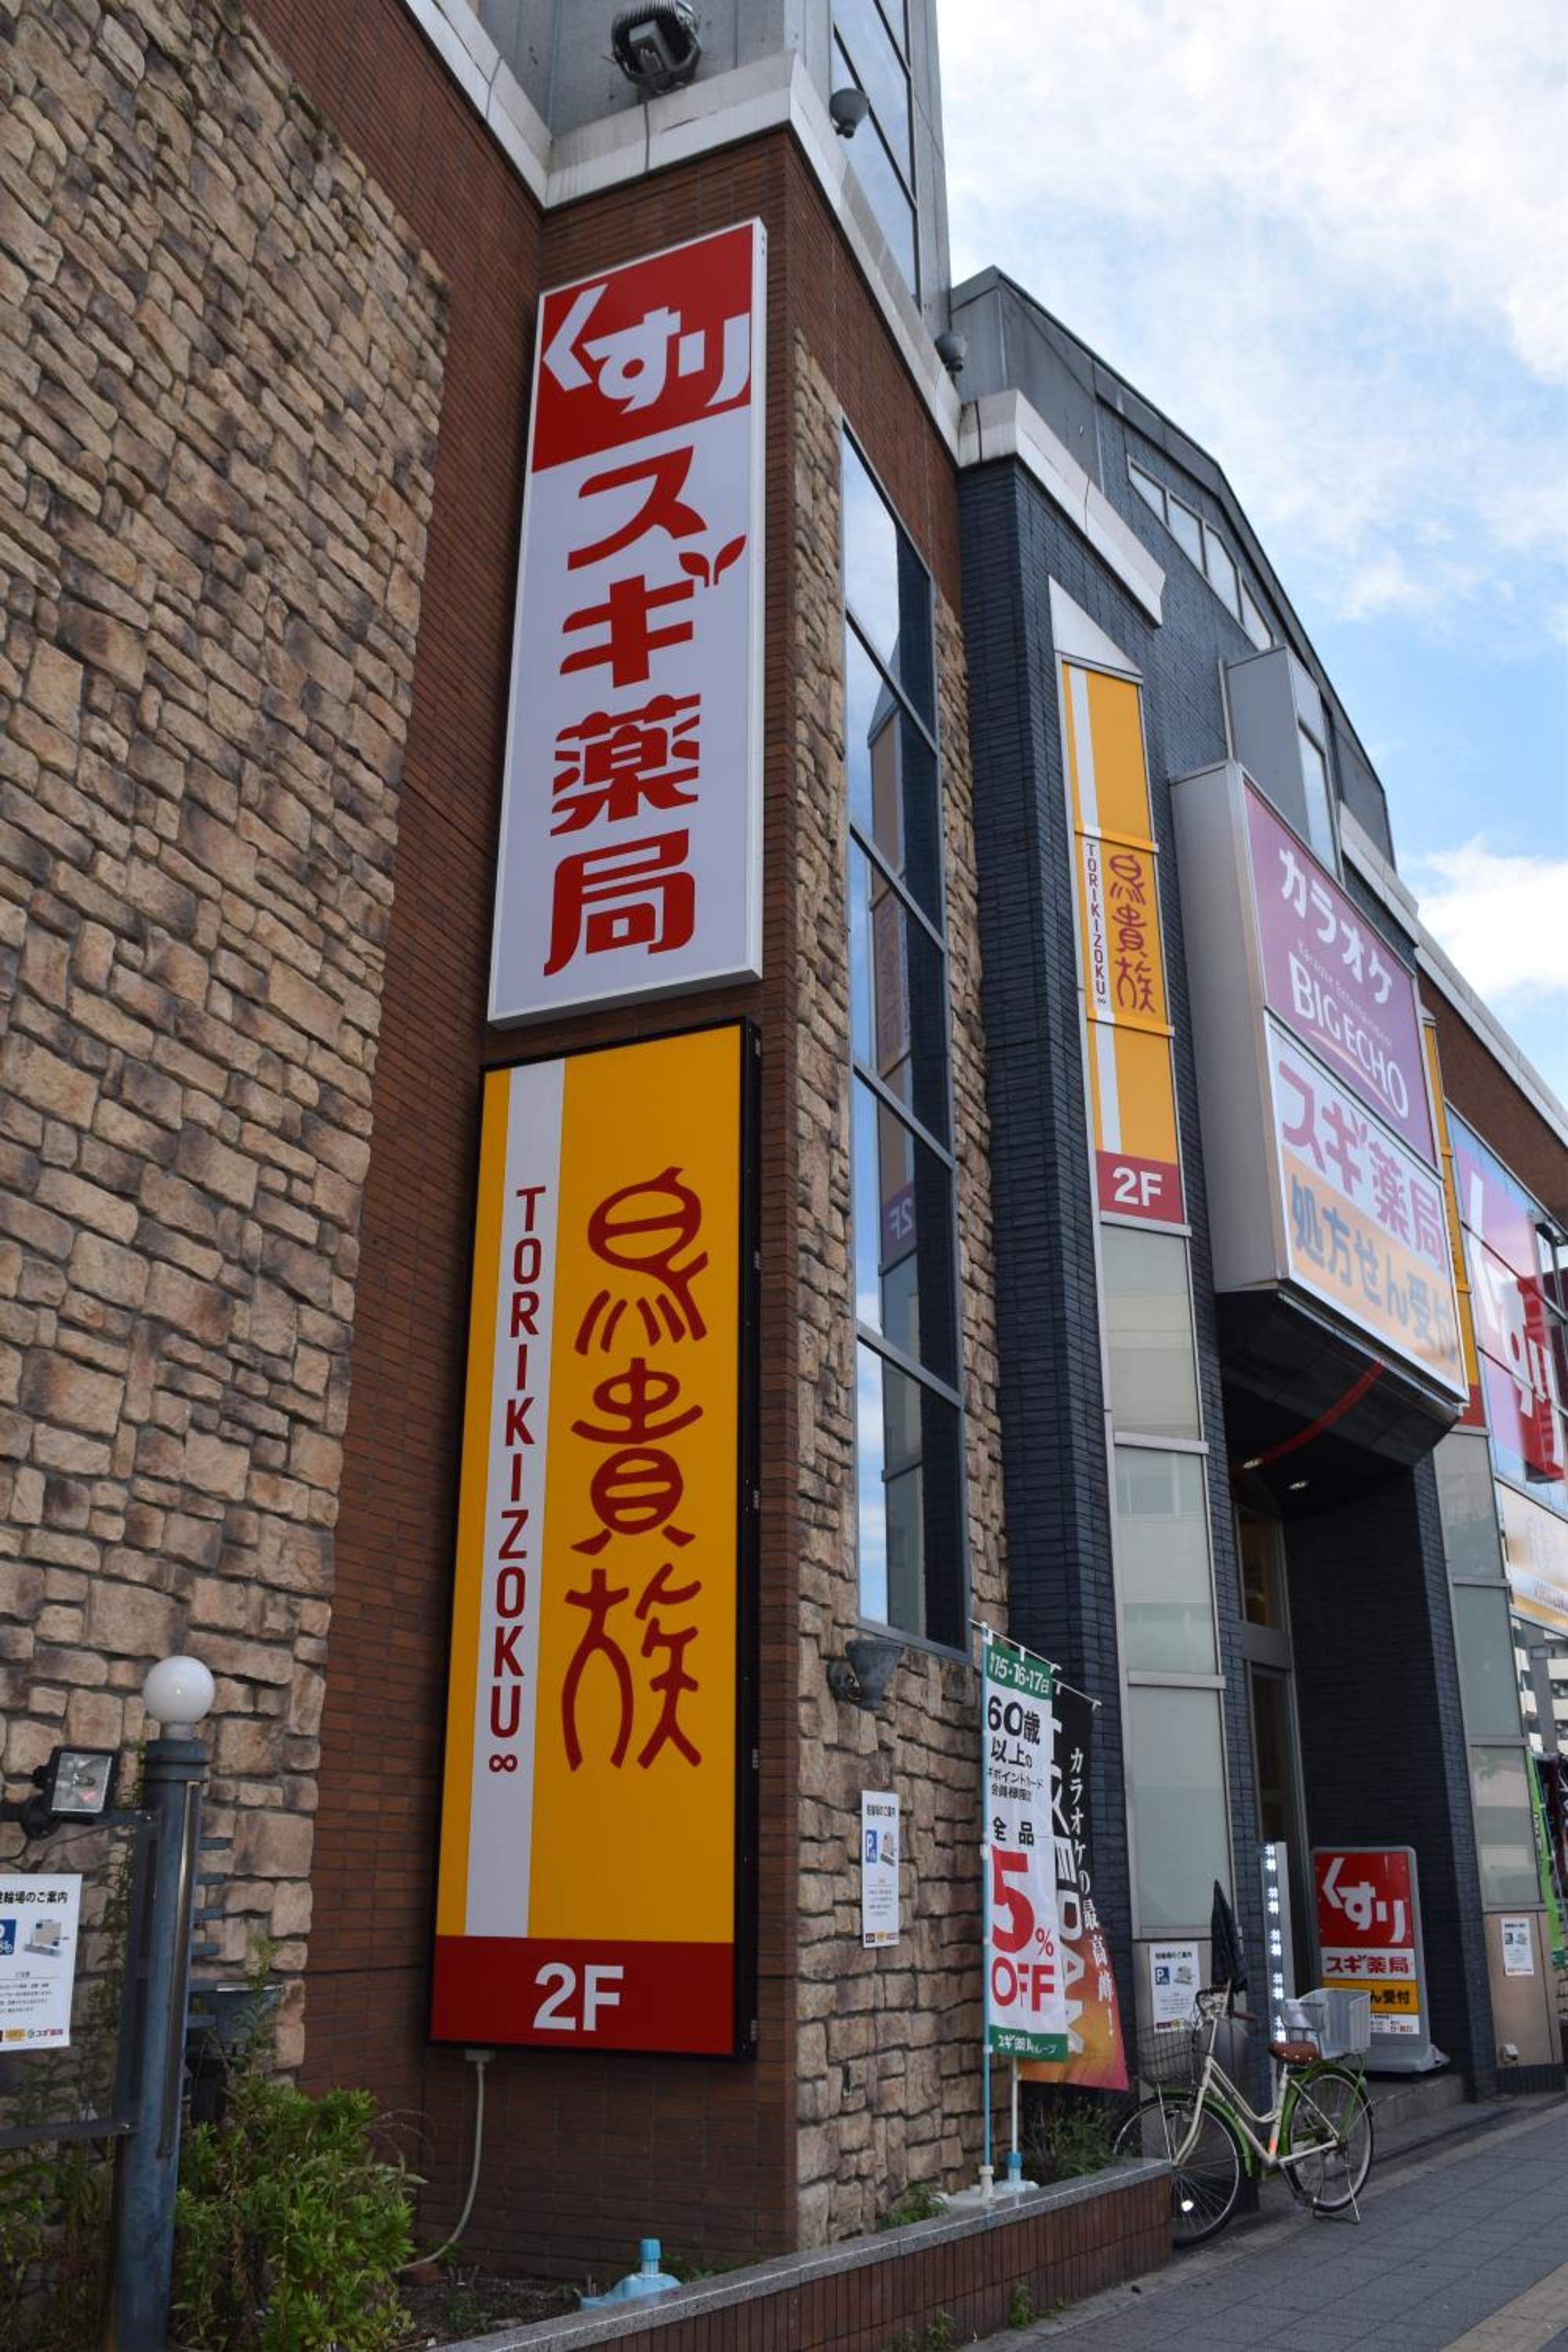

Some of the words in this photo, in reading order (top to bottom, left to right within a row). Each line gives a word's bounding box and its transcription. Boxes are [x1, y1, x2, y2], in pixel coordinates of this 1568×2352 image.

[542, 283, 750, 413] くすり
[543, 444, 746, 977] スギ薬局
[1086, 843, 1105, 996] TORIKIZOKU
[1279, 848, 1393, 1004] カラオケ
[1288, 951, 1341, 1041] BIG
[1342, 1012, 1409, 1119] ECHO
[1111, 1165, 1163, 1207] 2F
[1279, 1060, 1444, 1269] スギ薬局
[1291, 1174, 1456, 1358] 処方せん受付
[488, 1185, 547, 1740] TORIKIZOKU
[987, 1696, 1041, 1745] 60歳
[990, 1737, 1033, 1769] 以上の
[993, 1817, 1034, 1846] 全品
[991, 1844, 1054, 1958] 5%
[1322, 1857, 1406, 1944] くすり
[532, 1962, 626, 2031] 2F
[991, 1956, 1054, 2012] OFF
[1327, 1955, 1409, 1974] スギ薬局
